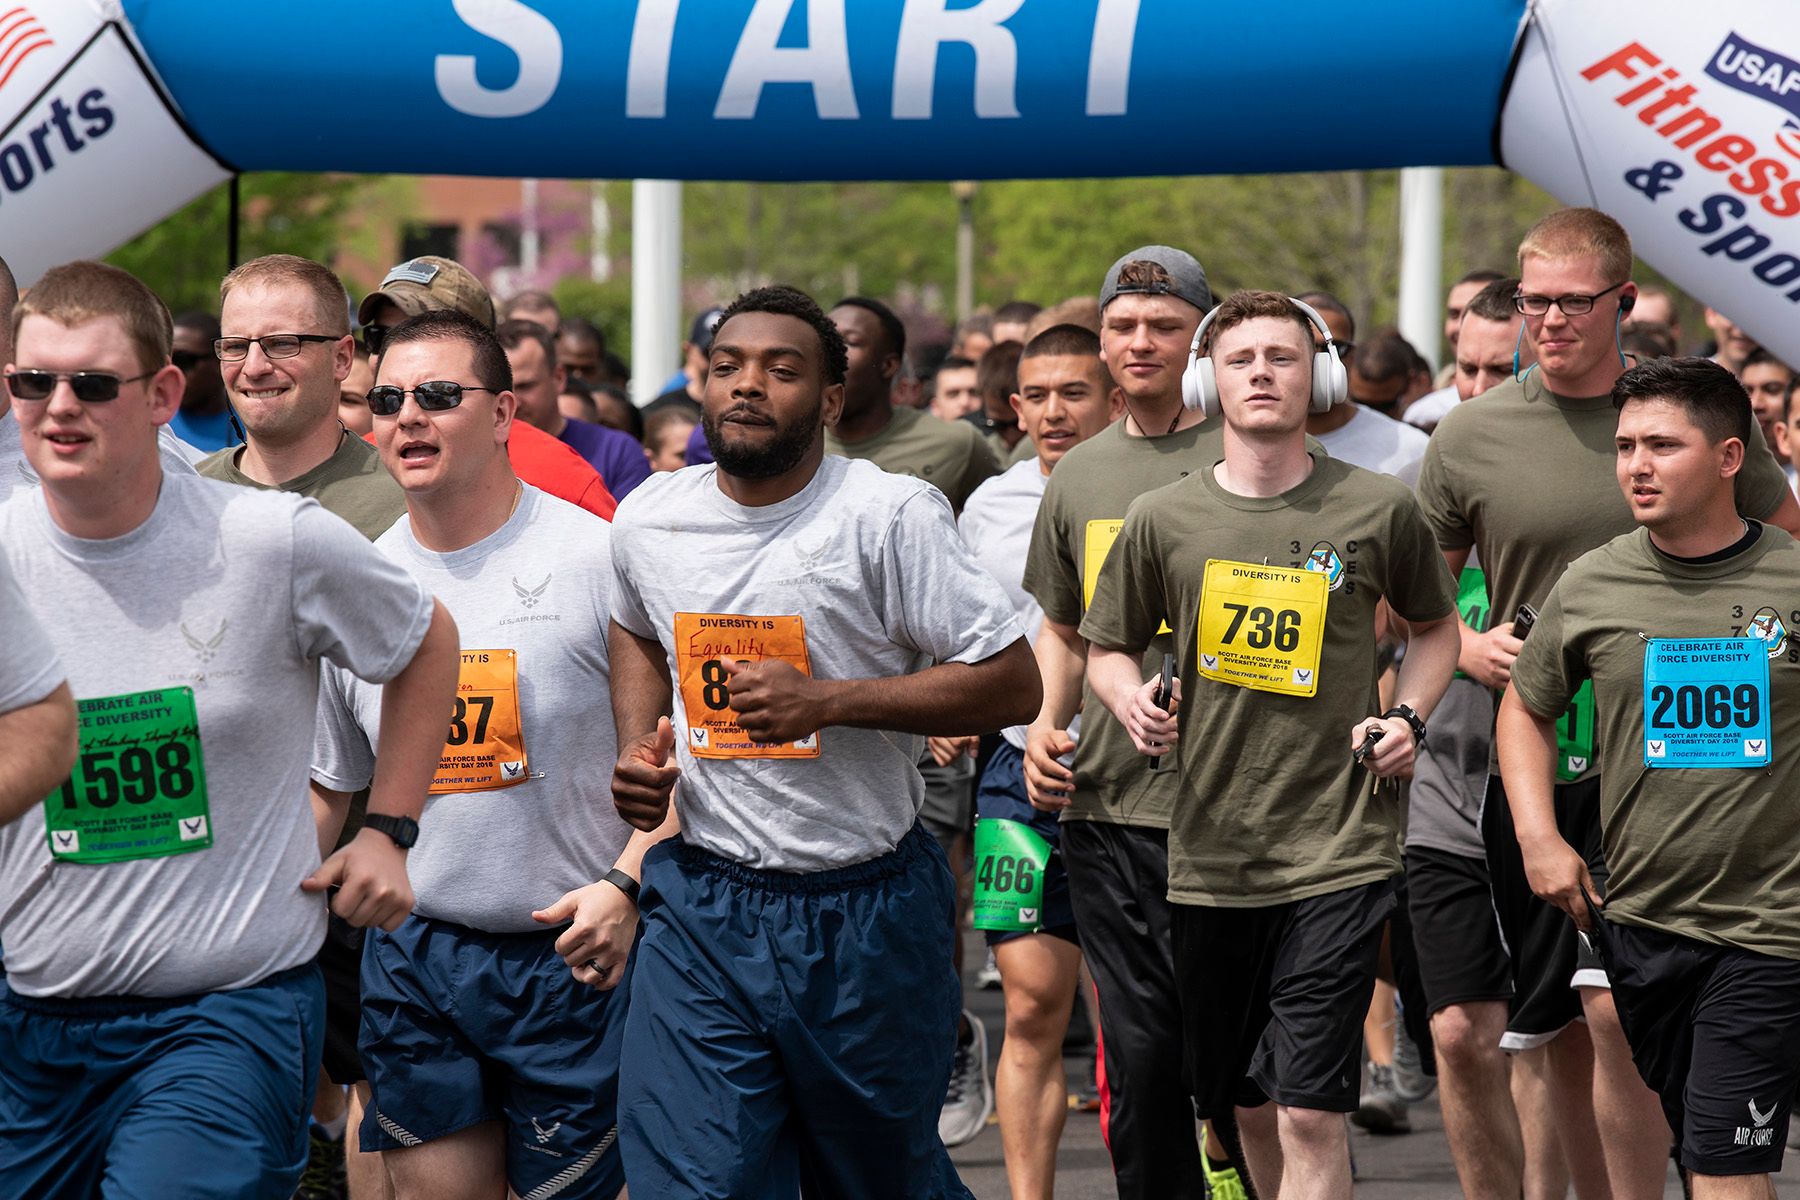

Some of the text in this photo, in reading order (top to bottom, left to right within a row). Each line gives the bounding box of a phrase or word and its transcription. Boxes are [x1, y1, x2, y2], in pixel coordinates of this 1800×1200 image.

[1716, 43, 1800, 97] USAF
[1580, 42, 1800, 218] Fitness
[1625, 160, 1800, 303] & Spo
[1232, 568, 1301, 583] DIVERSITY IS
[700, 618, 774, 629] DIVERSITY IS
[1221, 603, 1302, 652] 736
[690, 629, 763, 661] Equality
[1661, 642, 1744, 652] CELEBRATE AIR
[479, 654, 489, 663] IS
[1224, 657, 1257, 667] DIVERSITY
[1657, 653, 1750, 663] FORCE DIVERSITY
[1224, 669, 1257, 679] TOGETHER
[139, 693, 163, 704] AIR
[1651, 684, 1760, 729] 2069
[96, 707, 172, 727] DIVERSITY
[61, 742, 194, 810] 1598
[975, 855, 1036, 894] 466
[1734, 1126, 1750, 1145] AIR
